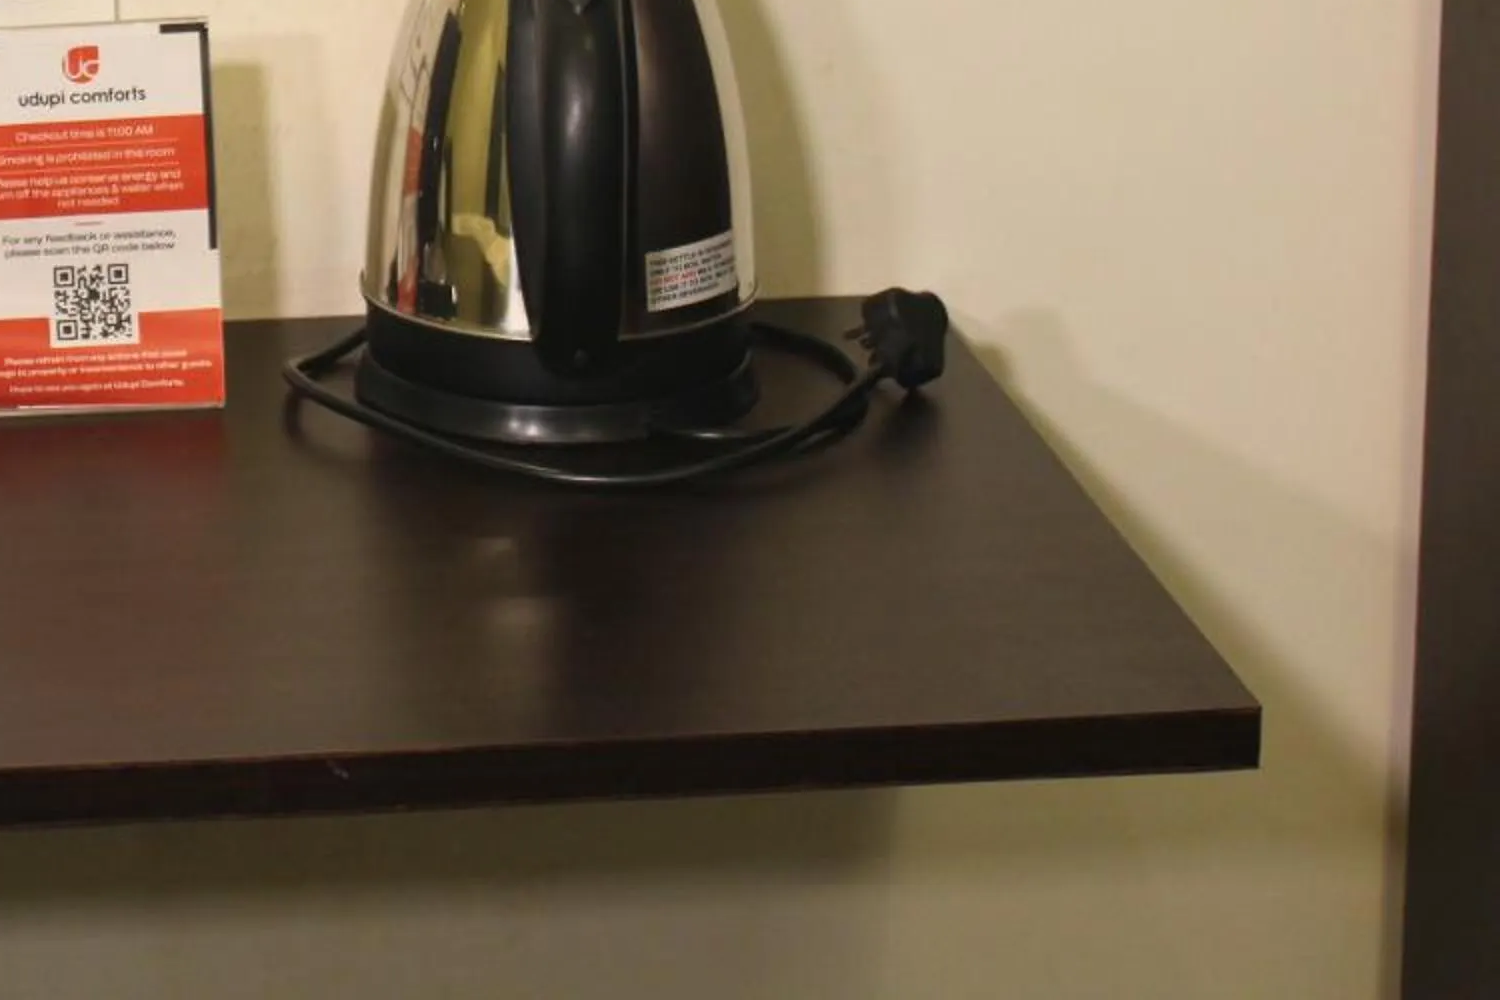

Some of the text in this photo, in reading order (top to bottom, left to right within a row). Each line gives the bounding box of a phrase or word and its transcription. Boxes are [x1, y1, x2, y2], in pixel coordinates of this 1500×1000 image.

[18, 87, 146, 109] udupi comforts
[15, 129, 67, 142] Checkout
[69, 128, 93, 139] time
[95, 127, 104, 137] is
[134, 124, 153, 135] AM
[46, 153, 54, 163] is
[56, 150, 109, 165] prohibited
[112, 149, 122, 159] in
[124, 148, 143, 158] this
[30, 175, 52, 188] help
[54, 176, 67, 184] us
[69, 173, 118, 184] conserve
[121, 171, 157, 184] energy
[160, 168, 180, 179] and
[15, 189, 29, 199] off
[31, 188, 47, 198] the
[51, 185, 108, 198] appliances
[111, 184, 118, 195] &
[121, 183, 150, 193] water
[153, 181, 183, 192] when
[57, 198, 74, 208] not
[2, 235, 19, 245] For
[23, 236, 42, 245] any
[45, 231, 96, 243] feedback
[4, 240, 174, 259] please scan the QR code below
